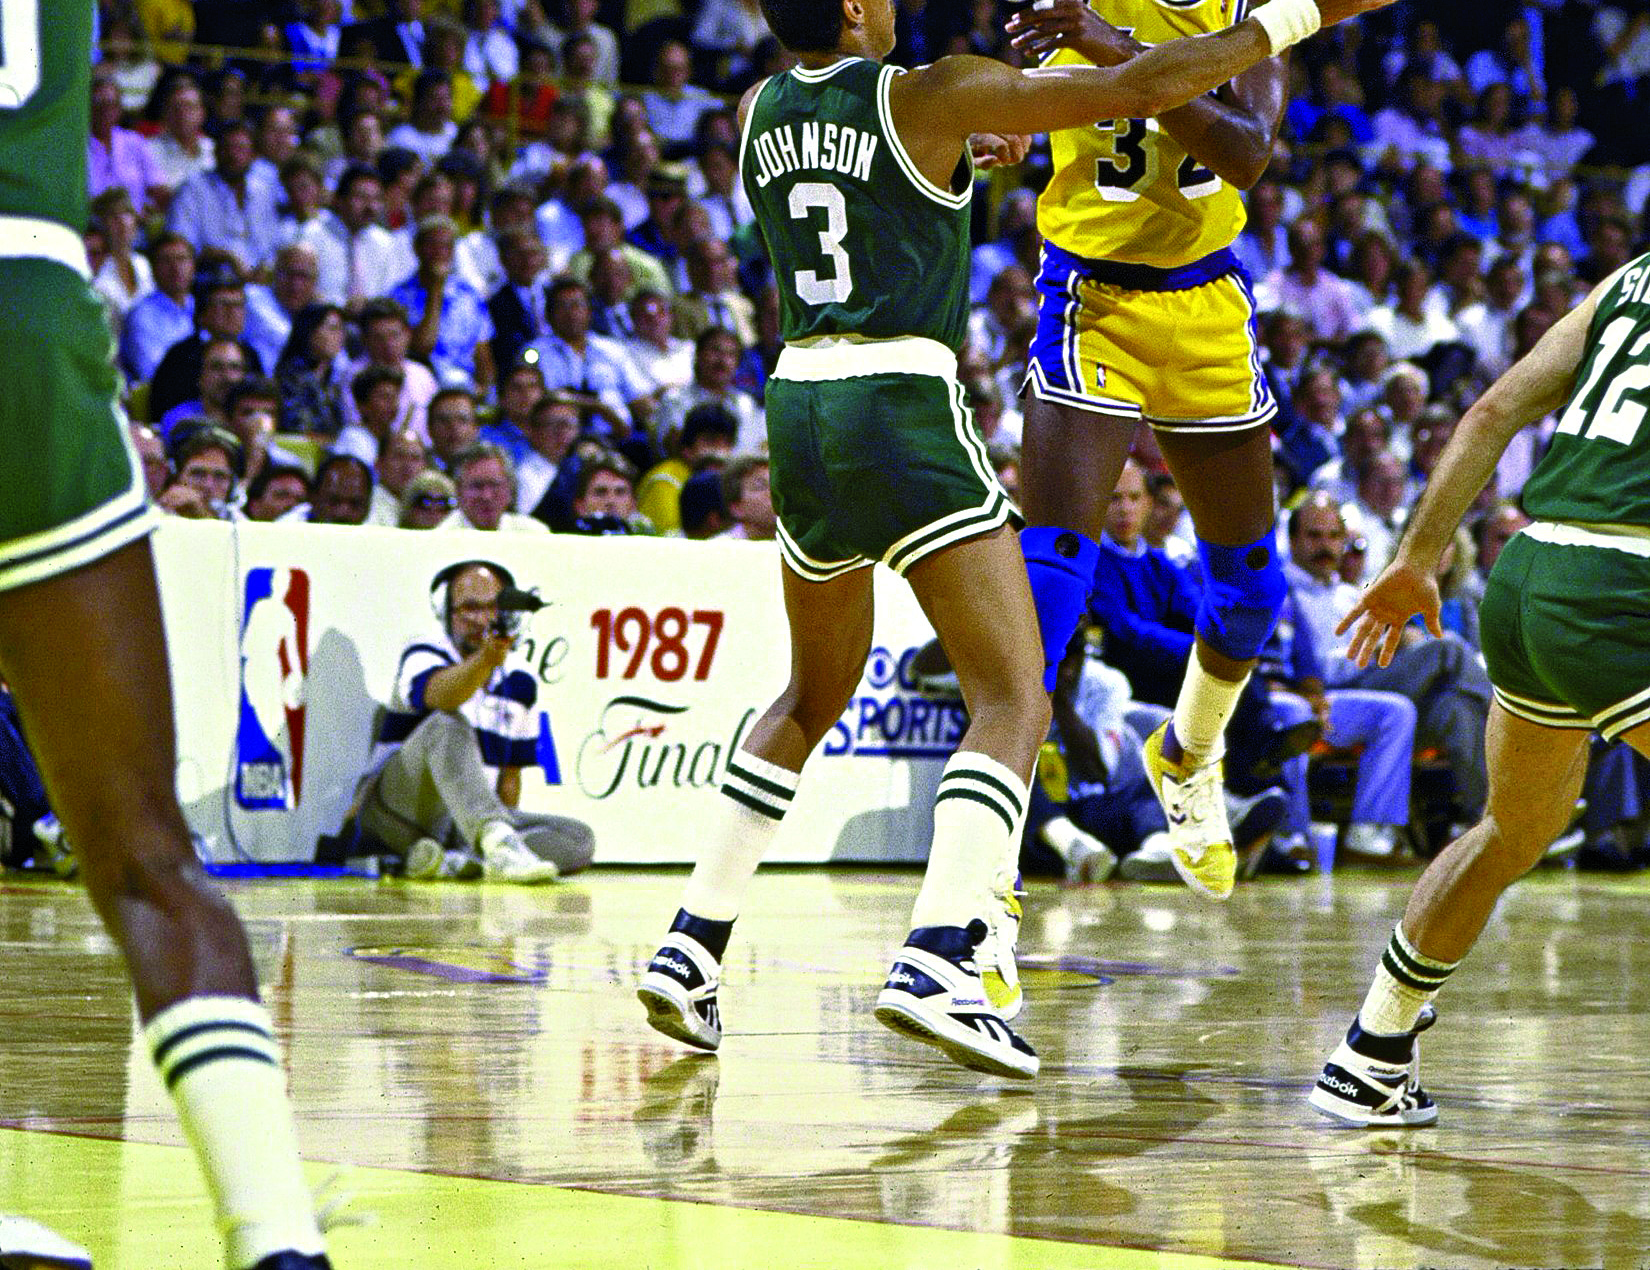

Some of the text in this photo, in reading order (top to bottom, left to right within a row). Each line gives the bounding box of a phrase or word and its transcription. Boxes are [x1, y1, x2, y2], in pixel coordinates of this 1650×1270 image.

[753, 121, 877, 187] JOHNSON
[788, 183, 853, 306] 3
[1556, 316, 1650, 446] 12
[591, 606, 723, 682] 1987
